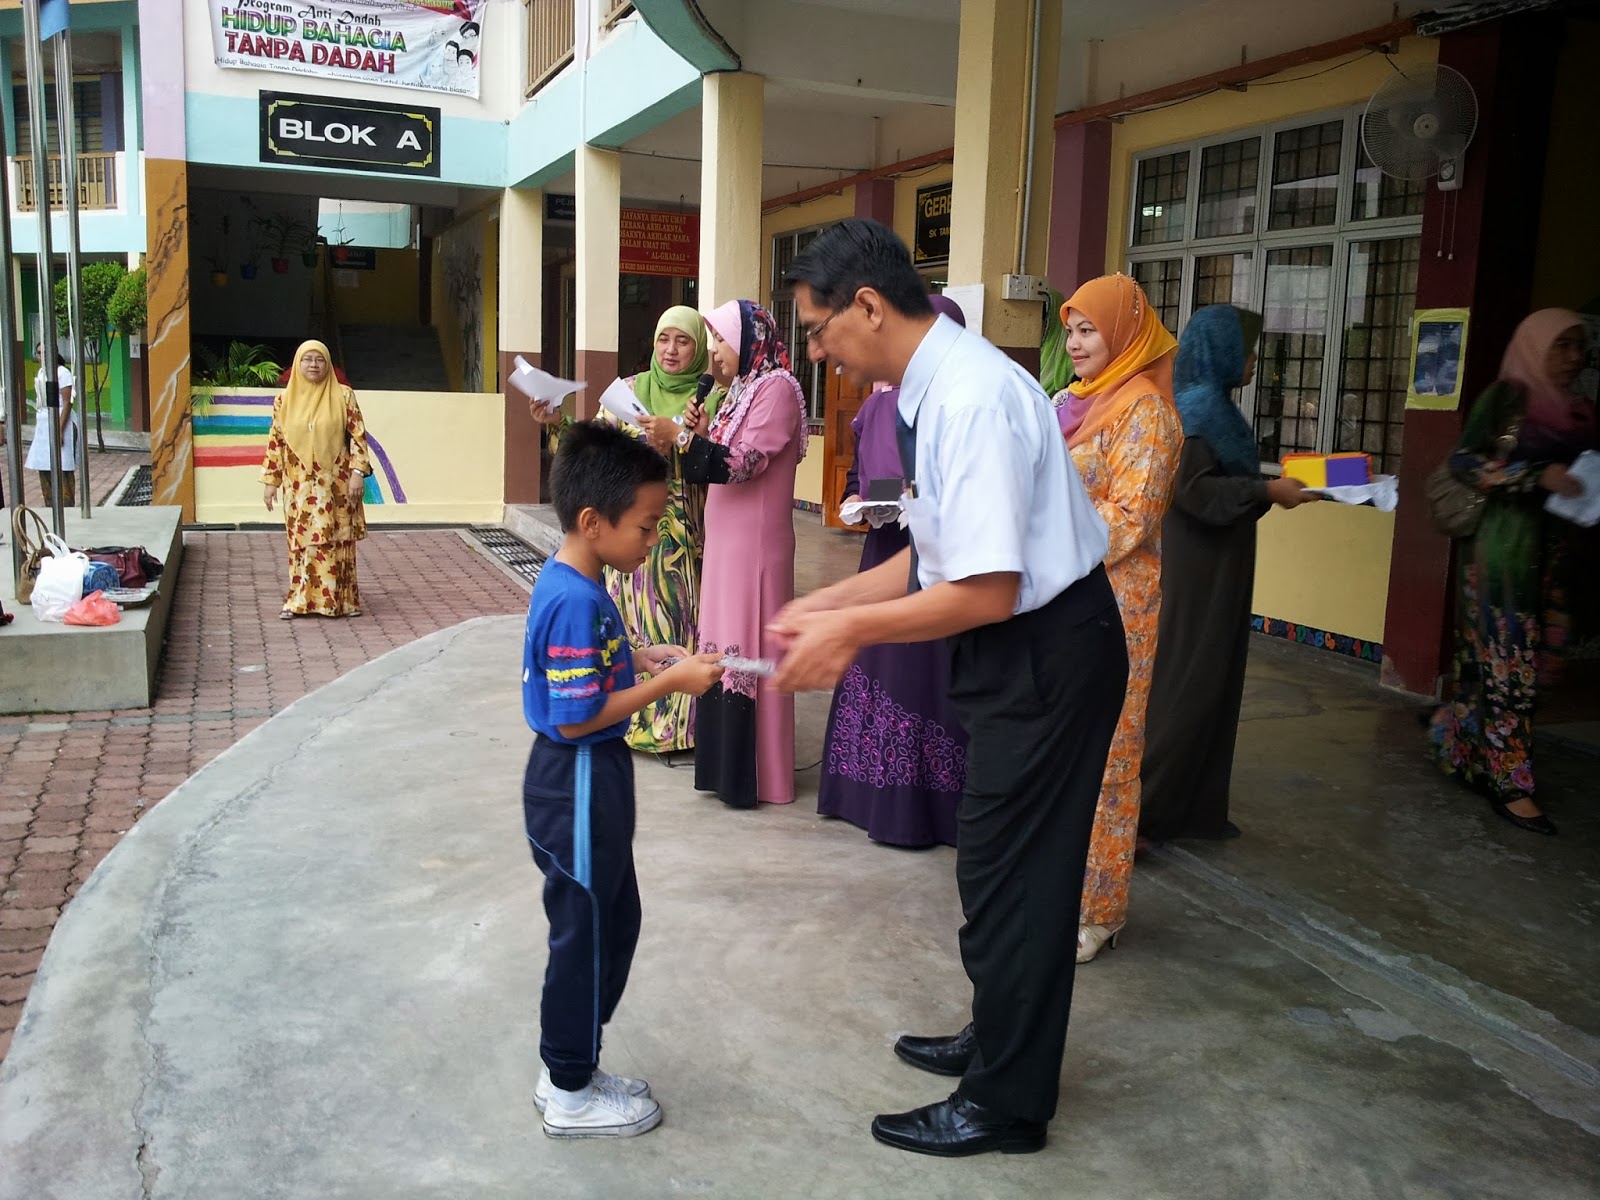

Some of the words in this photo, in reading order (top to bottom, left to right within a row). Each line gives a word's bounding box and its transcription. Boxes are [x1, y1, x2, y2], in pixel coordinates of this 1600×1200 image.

[238, 0, 293, 13] Program
[298, 5, 332, 19] Anti
[337, 10, 381, 26] Dadah
[221, 6, 297, 37] HIDUP
[302, 19, 407, 53] BAHAGIA
[225, 31, 306, 63] TANPA
[312, 43, 395, 74] DADAH
[216, 56, 237, 66] Hidup
[279, 118, 377, 147] BLOK
[396, 129, 422, 151] A
[622, 212, 649, 221] JAYANYA
[670, 216, 687, 225] UMAT
[620, 220, 645, 230] KERANA
[620, 230, 646, 239] SAKNYA
[928, 229, 937, 238] SK
[642, 241, 659, 249] UMAT
